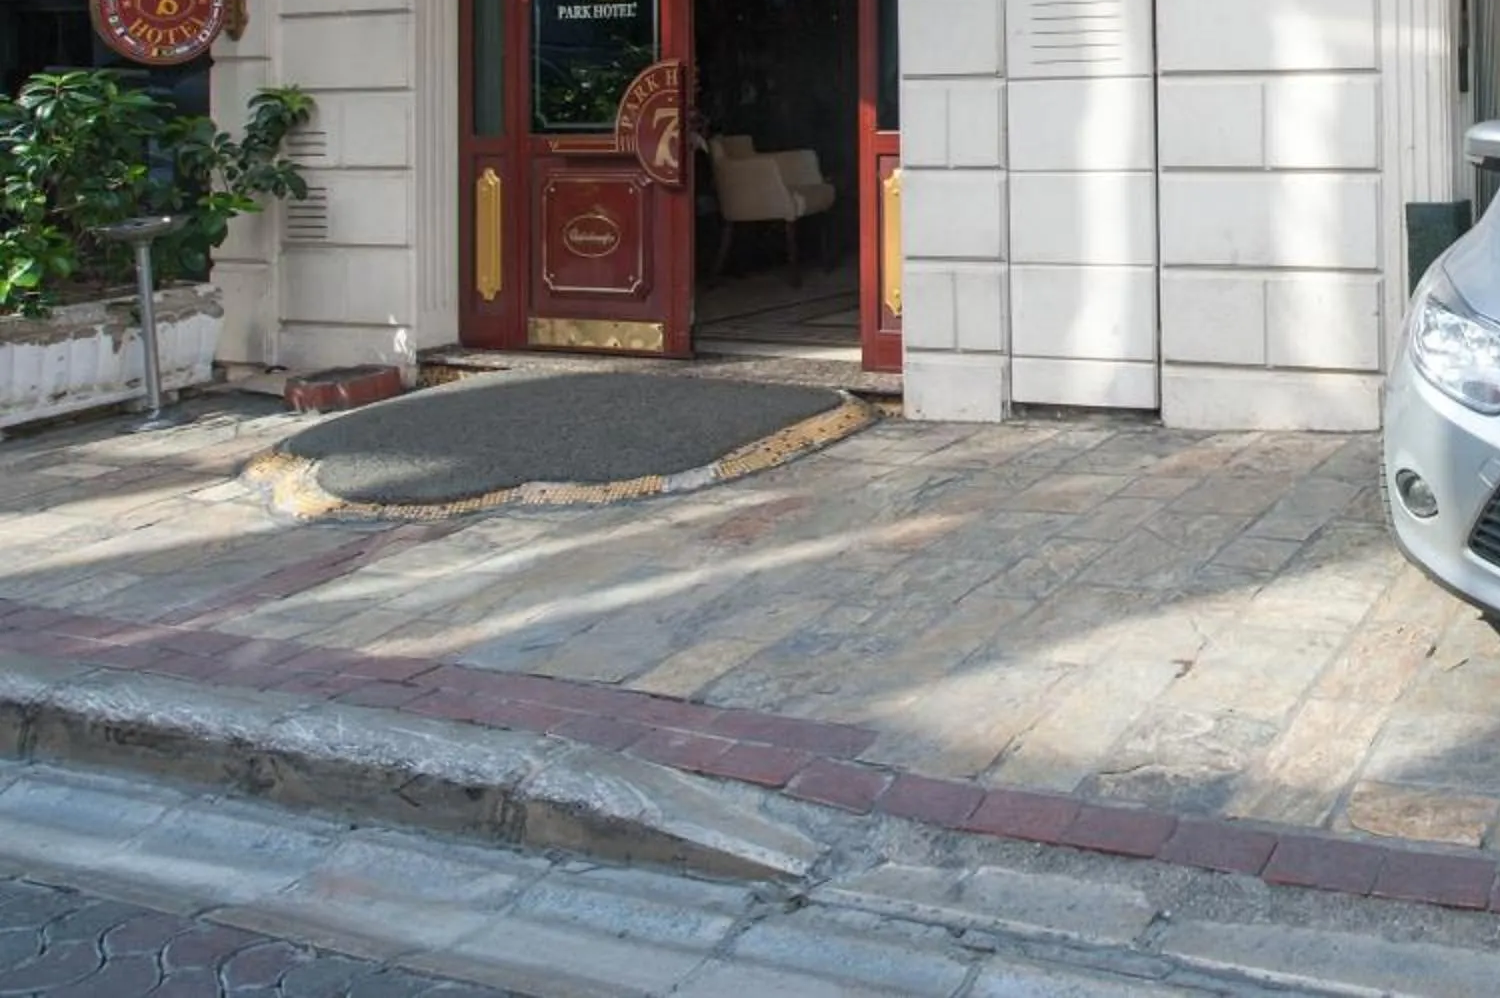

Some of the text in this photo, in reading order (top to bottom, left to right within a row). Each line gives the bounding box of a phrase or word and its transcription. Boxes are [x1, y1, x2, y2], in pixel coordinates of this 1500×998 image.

[557, 2, 637, 20] PARK HOTEL
[128, 17, 205, 45] HOTEL
[620, 73, 659, 129] PARK
